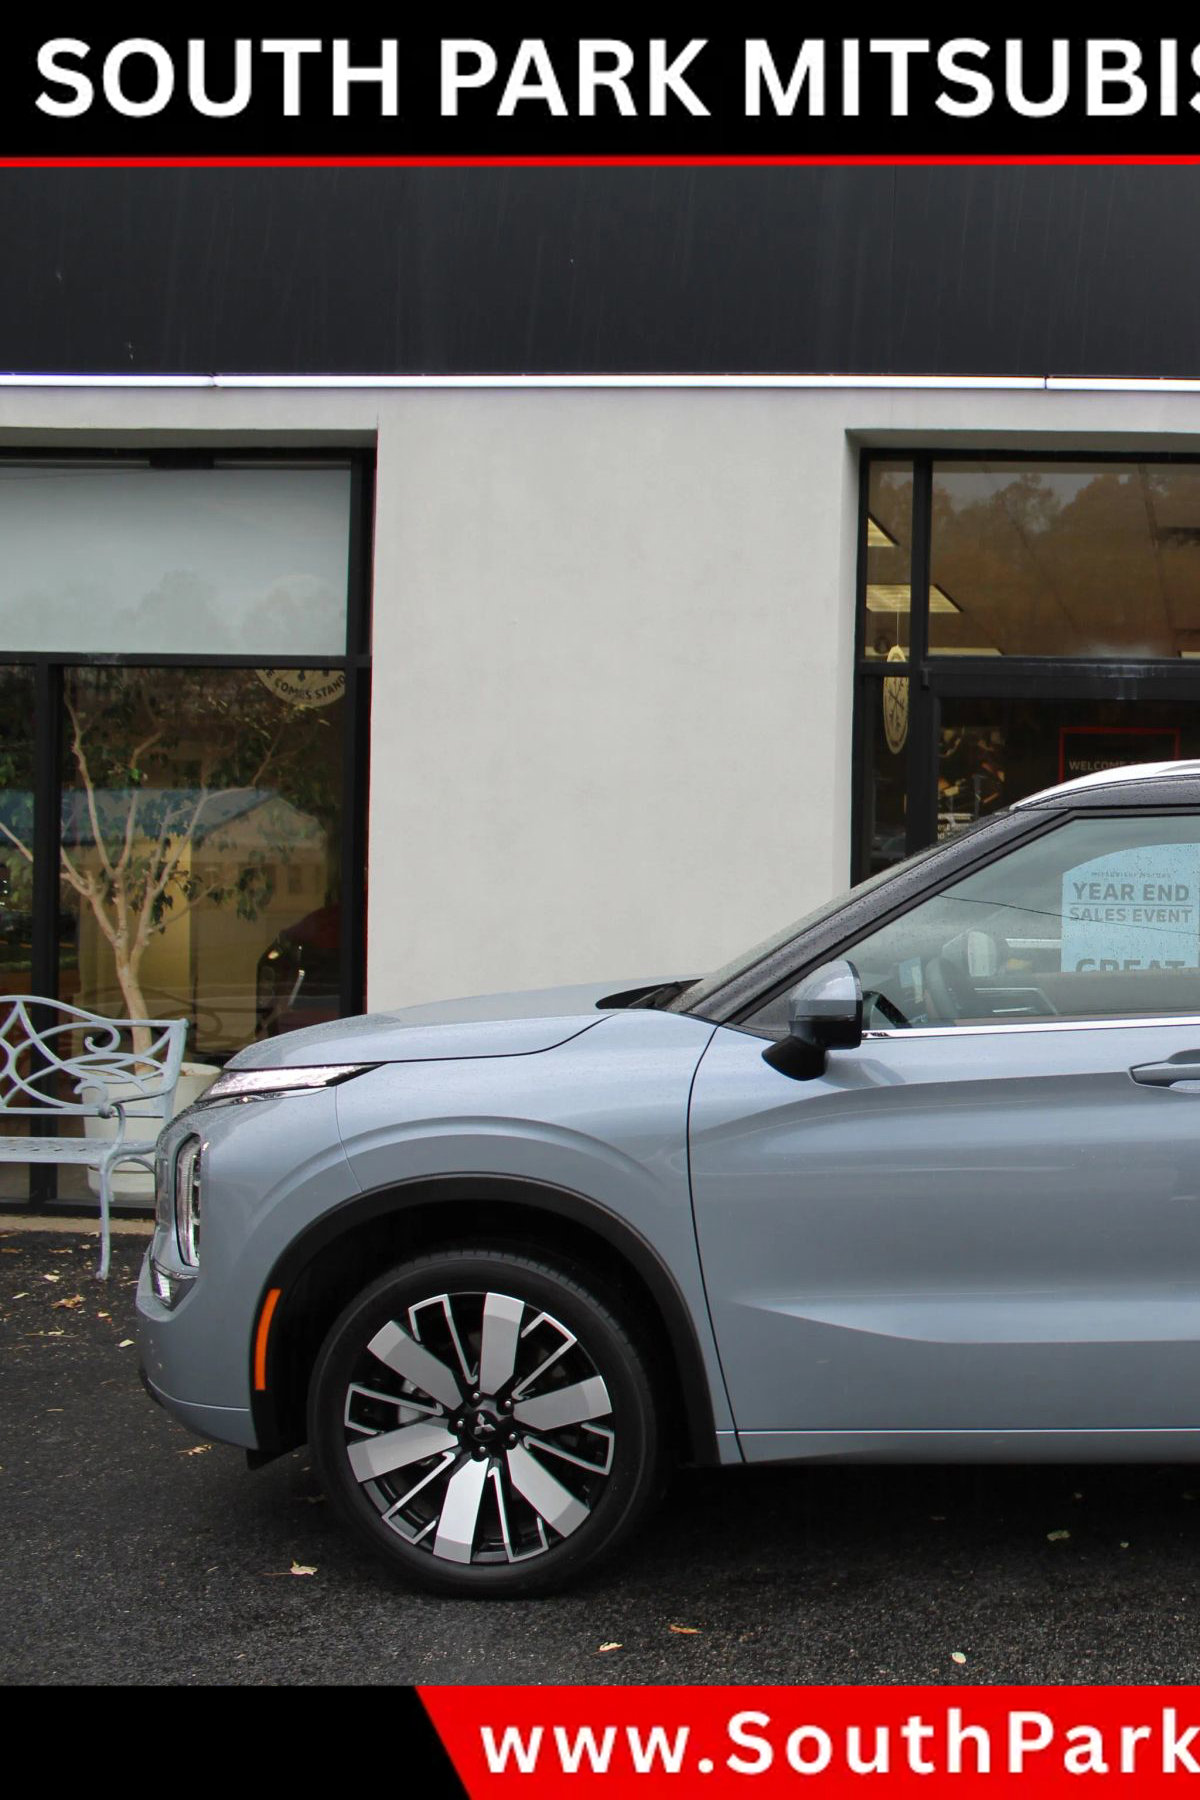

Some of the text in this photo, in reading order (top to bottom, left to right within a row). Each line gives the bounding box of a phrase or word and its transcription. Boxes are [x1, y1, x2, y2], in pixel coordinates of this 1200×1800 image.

[1072, 882, 1190, 902] YEAR END
[1069, 907, 1192, 923] SALES EVENT
